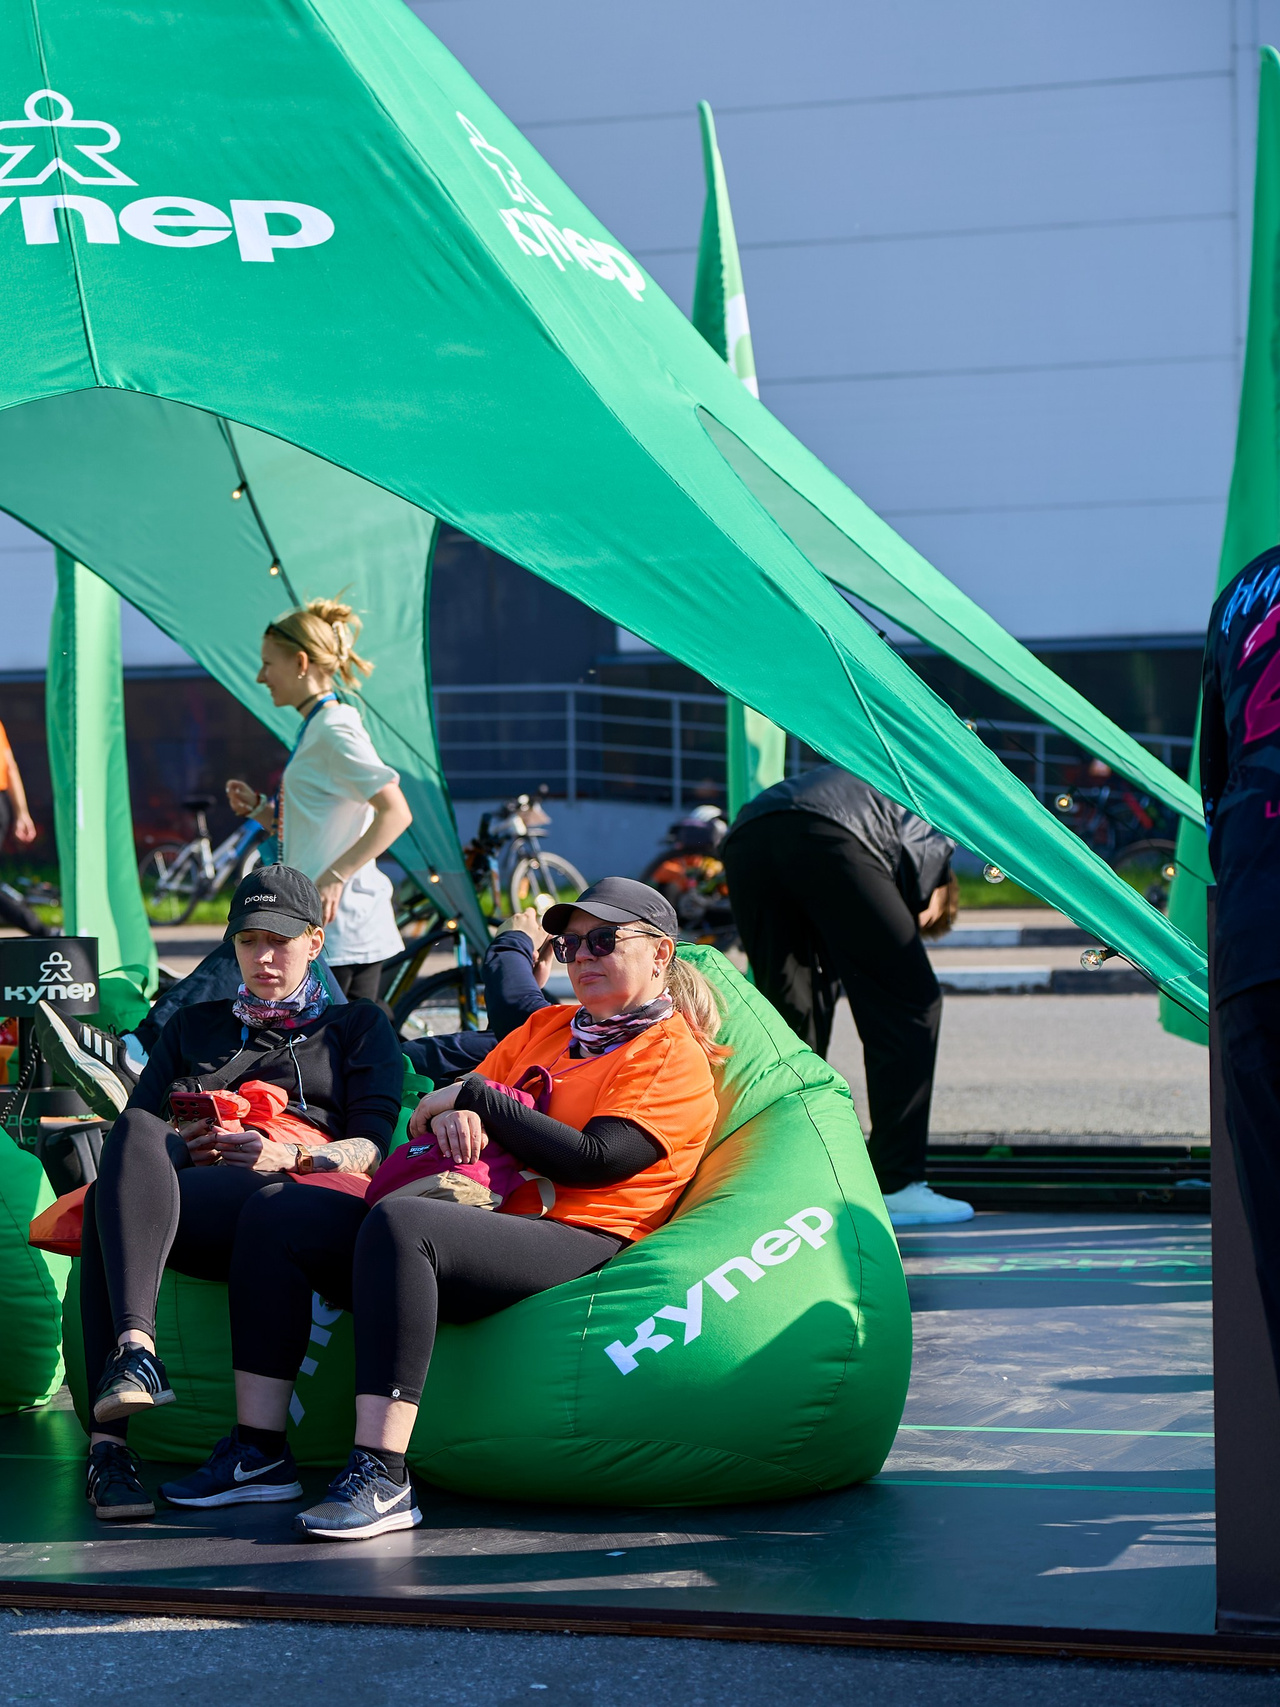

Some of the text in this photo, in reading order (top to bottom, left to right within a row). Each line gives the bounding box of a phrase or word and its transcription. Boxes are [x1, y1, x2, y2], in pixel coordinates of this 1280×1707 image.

[244, 894, 277, 905] protest
[4, 982, 96, 1005] купер
[603, 1206, 835, 1376] купер
